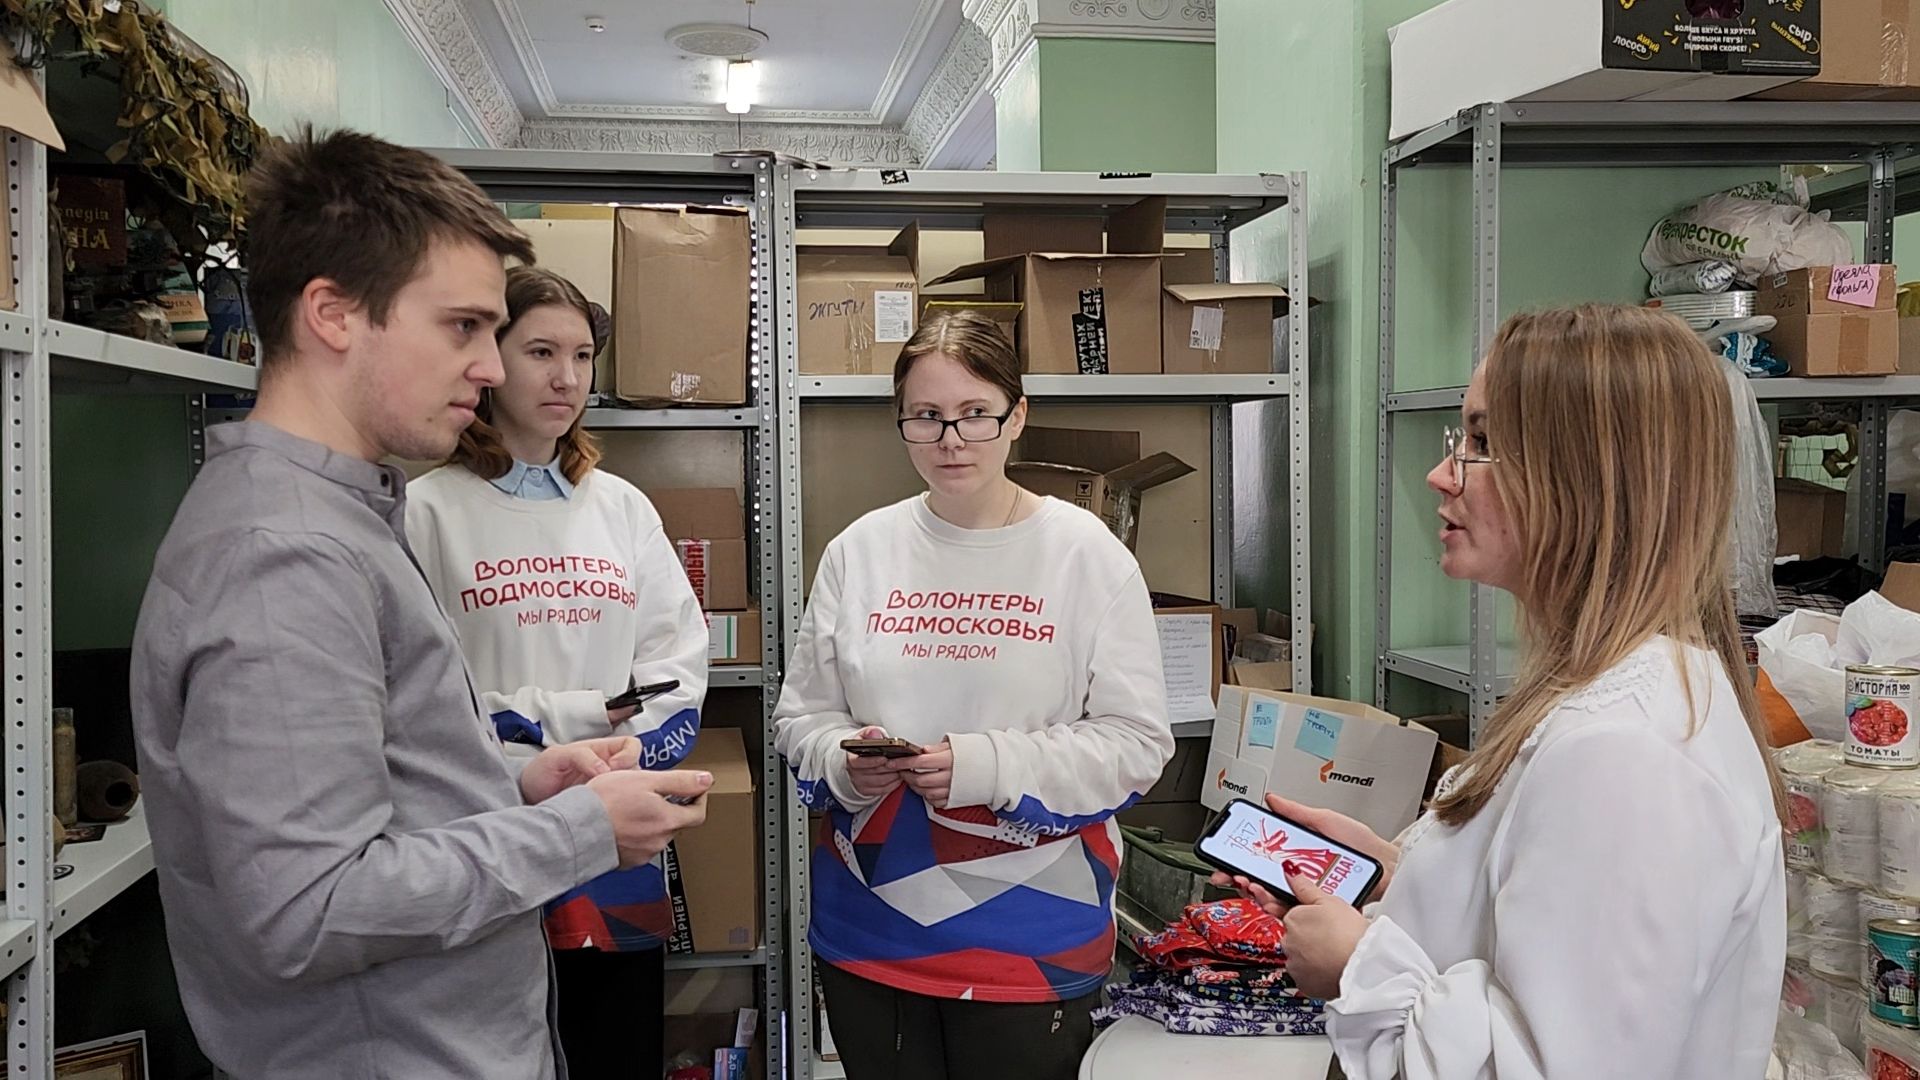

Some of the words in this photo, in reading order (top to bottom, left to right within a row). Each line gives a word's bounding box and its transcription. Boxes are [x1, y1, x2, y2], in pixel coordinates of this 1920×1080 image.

[1788, 24, 1812, 43] СЫР
[1613, 35, 1648, 54] ЛОСОСЬ
[808, 299, 865, 320] ЖГУТЫ
[475, 556, 628, 582] ВОЛОНТЕРЫ
[461, 580, 636, 612] ПОДМОСКОВЬЯ
[886, 589, 1044, 615] ВОЛОНТЕРЫ
[517, 611, 542, 627] МЫ
[866, 613, 1055, 643] ПОДМОСКОВЬЯ
[902, 643, 933, 658] МЫ
[935, 644, 997, 661] РЯДОМ
[1854, 681, 1898, 696] ИСТОРИЯ
[1850, 745, 1900, 757] ТОМАТЫ
[1222, 778, 1249, 795] mondi
[1328, 770, 1375, 787] mondi
[1321, 855, 1357, 896] ОБЕДА!
